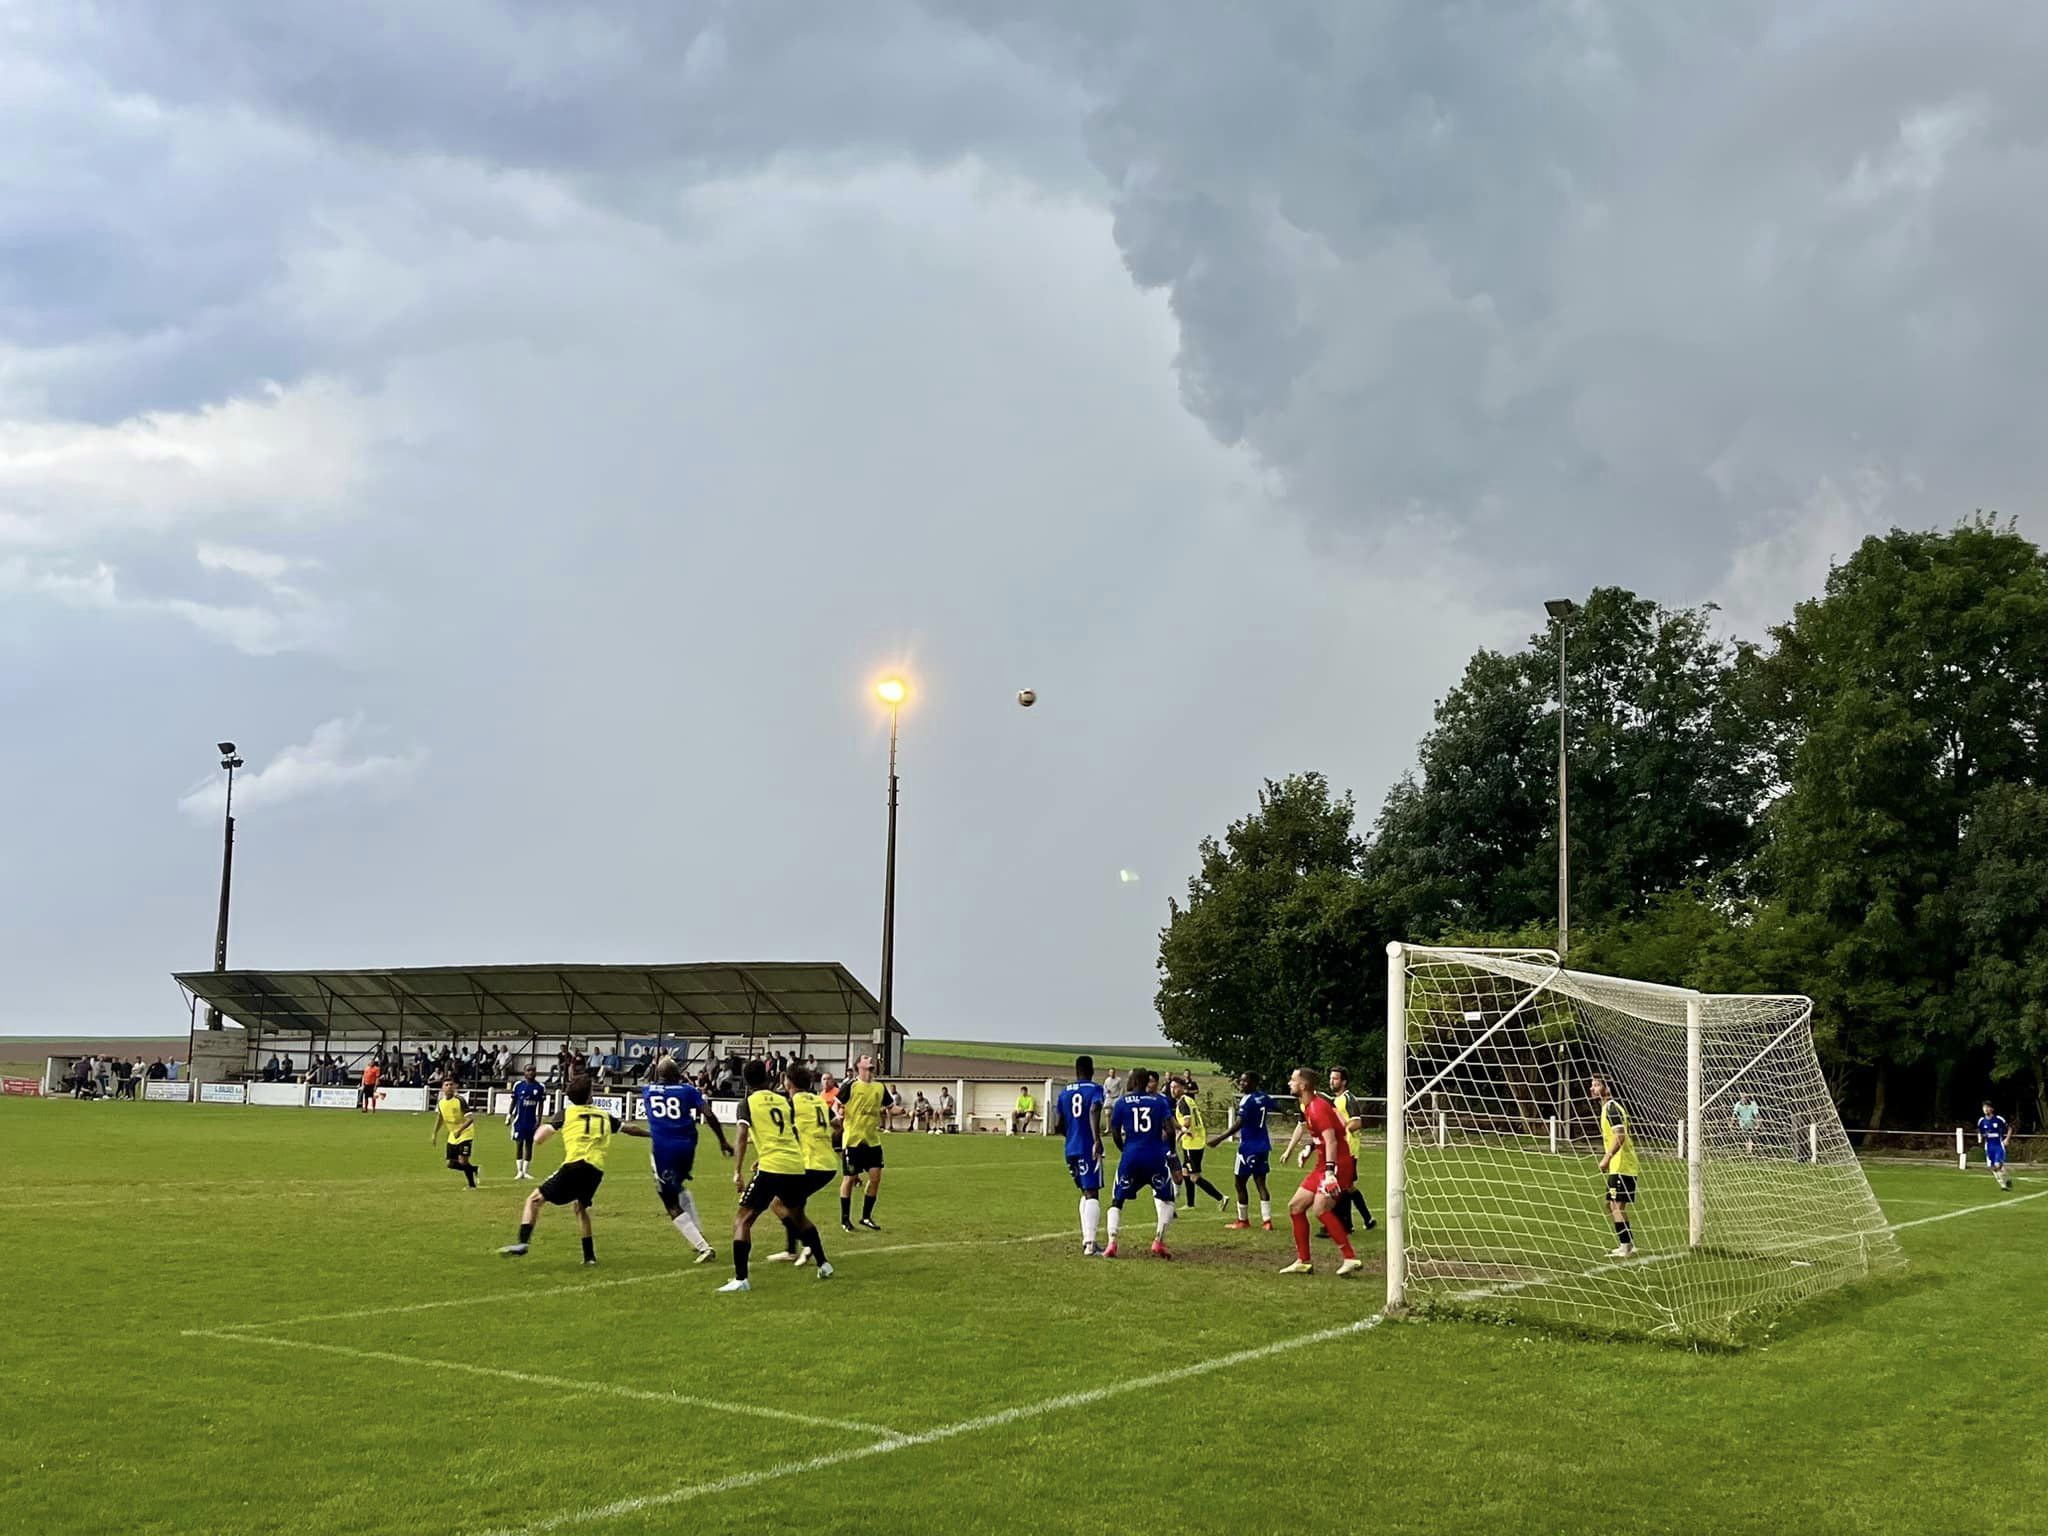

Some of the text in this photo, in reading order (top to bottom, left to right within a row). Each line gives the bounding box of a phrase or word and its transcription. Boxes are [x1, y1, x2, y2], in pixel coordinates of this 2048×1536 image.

[650, 1096, 681, 1119] 58
[815, 1106, 827, 1130] 4
[1072, 1093, 1082, 1118] 8
[770, 1107, 784, 1134] 9
[1132, 1107, 1151, 1133] 13
